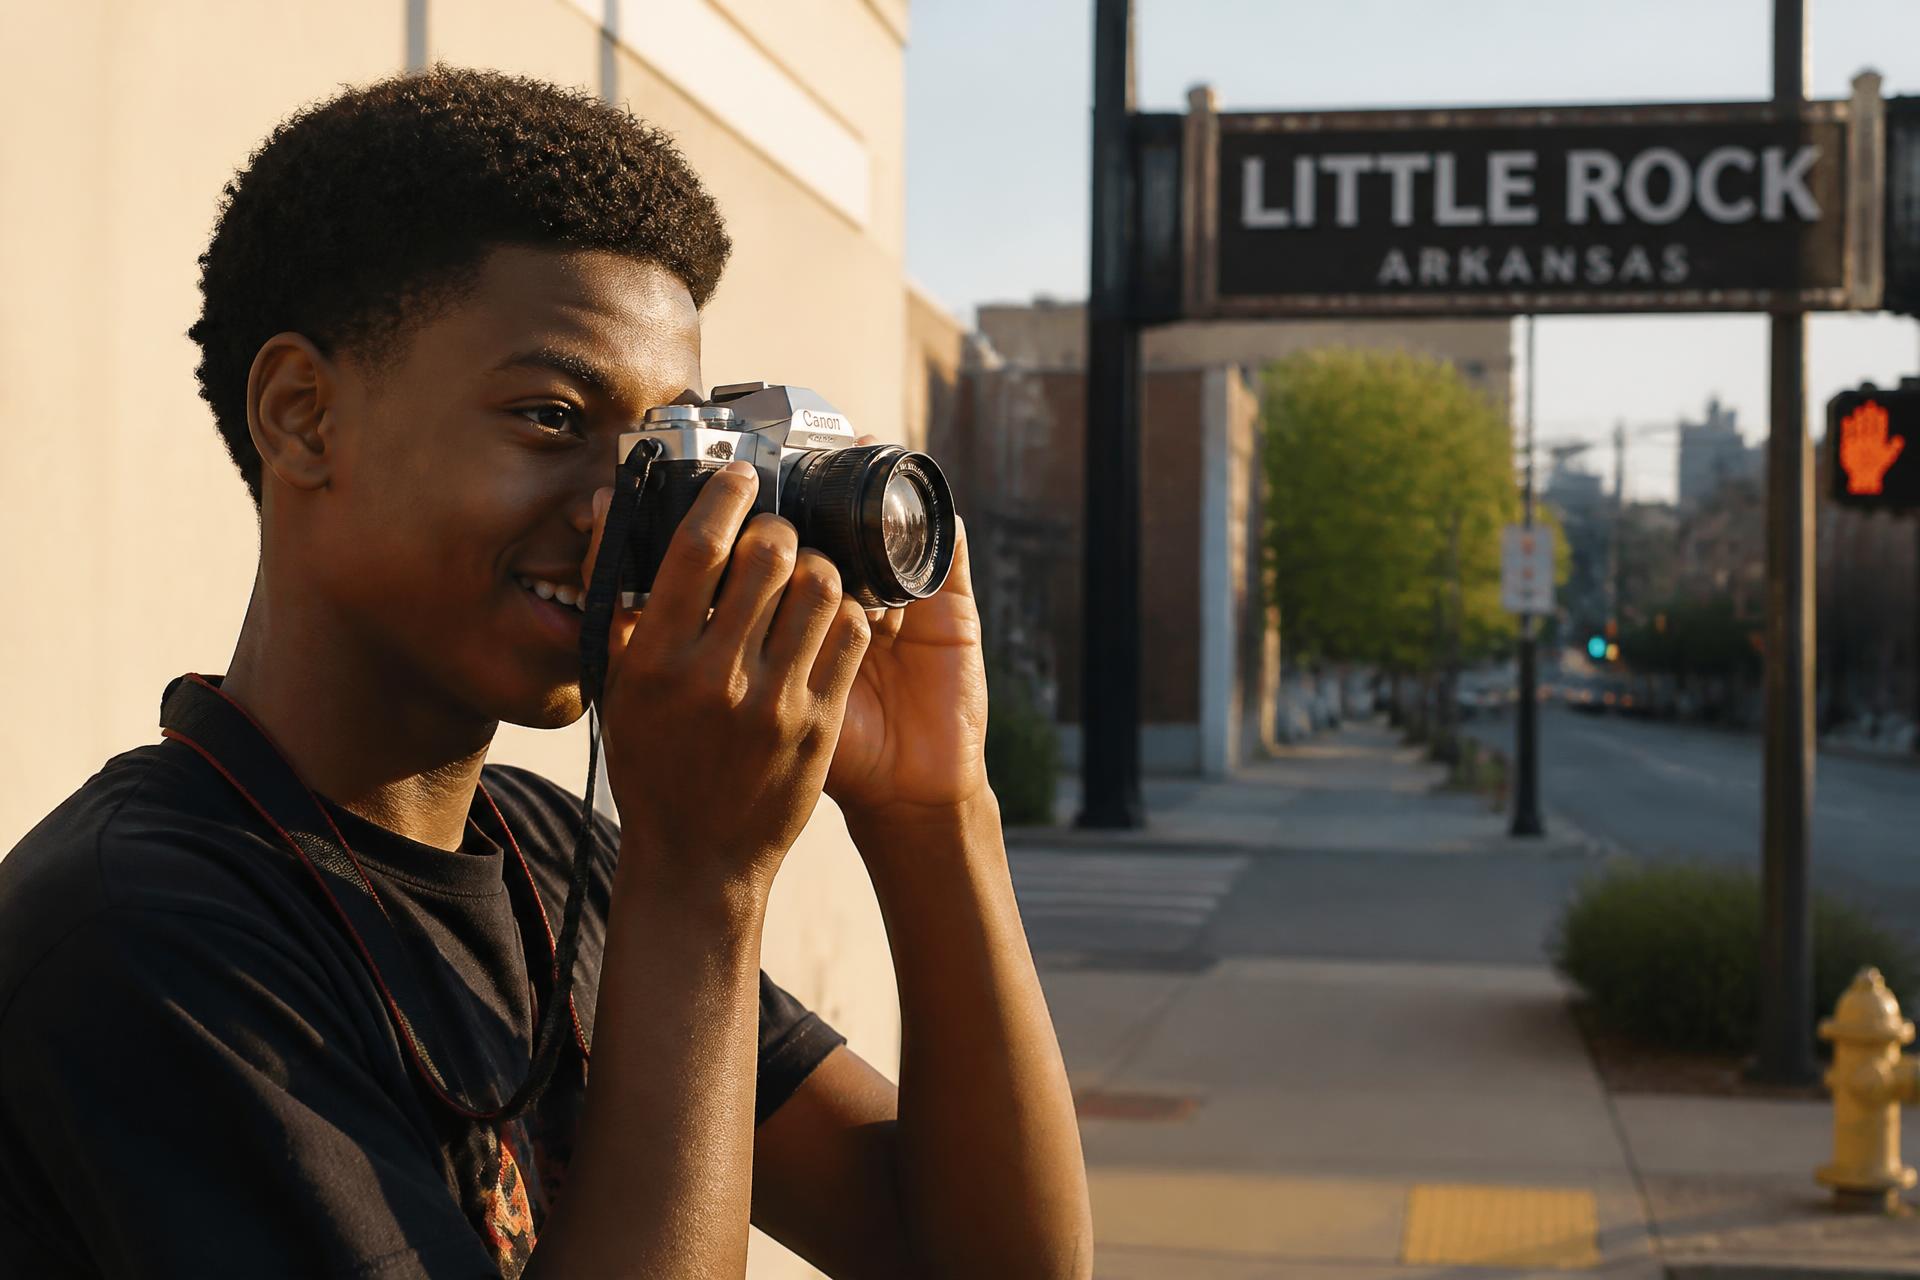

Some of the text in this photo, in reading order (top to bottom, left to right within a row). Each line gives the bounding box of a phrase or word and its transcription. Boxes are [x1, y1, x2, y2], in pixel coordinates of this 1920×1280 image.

[1241, 146, 1822, 229] LITTLE ROCK
[1378, 245, 1691, 285] ARKANSAS
[803, 410, 841, 431] Canon
